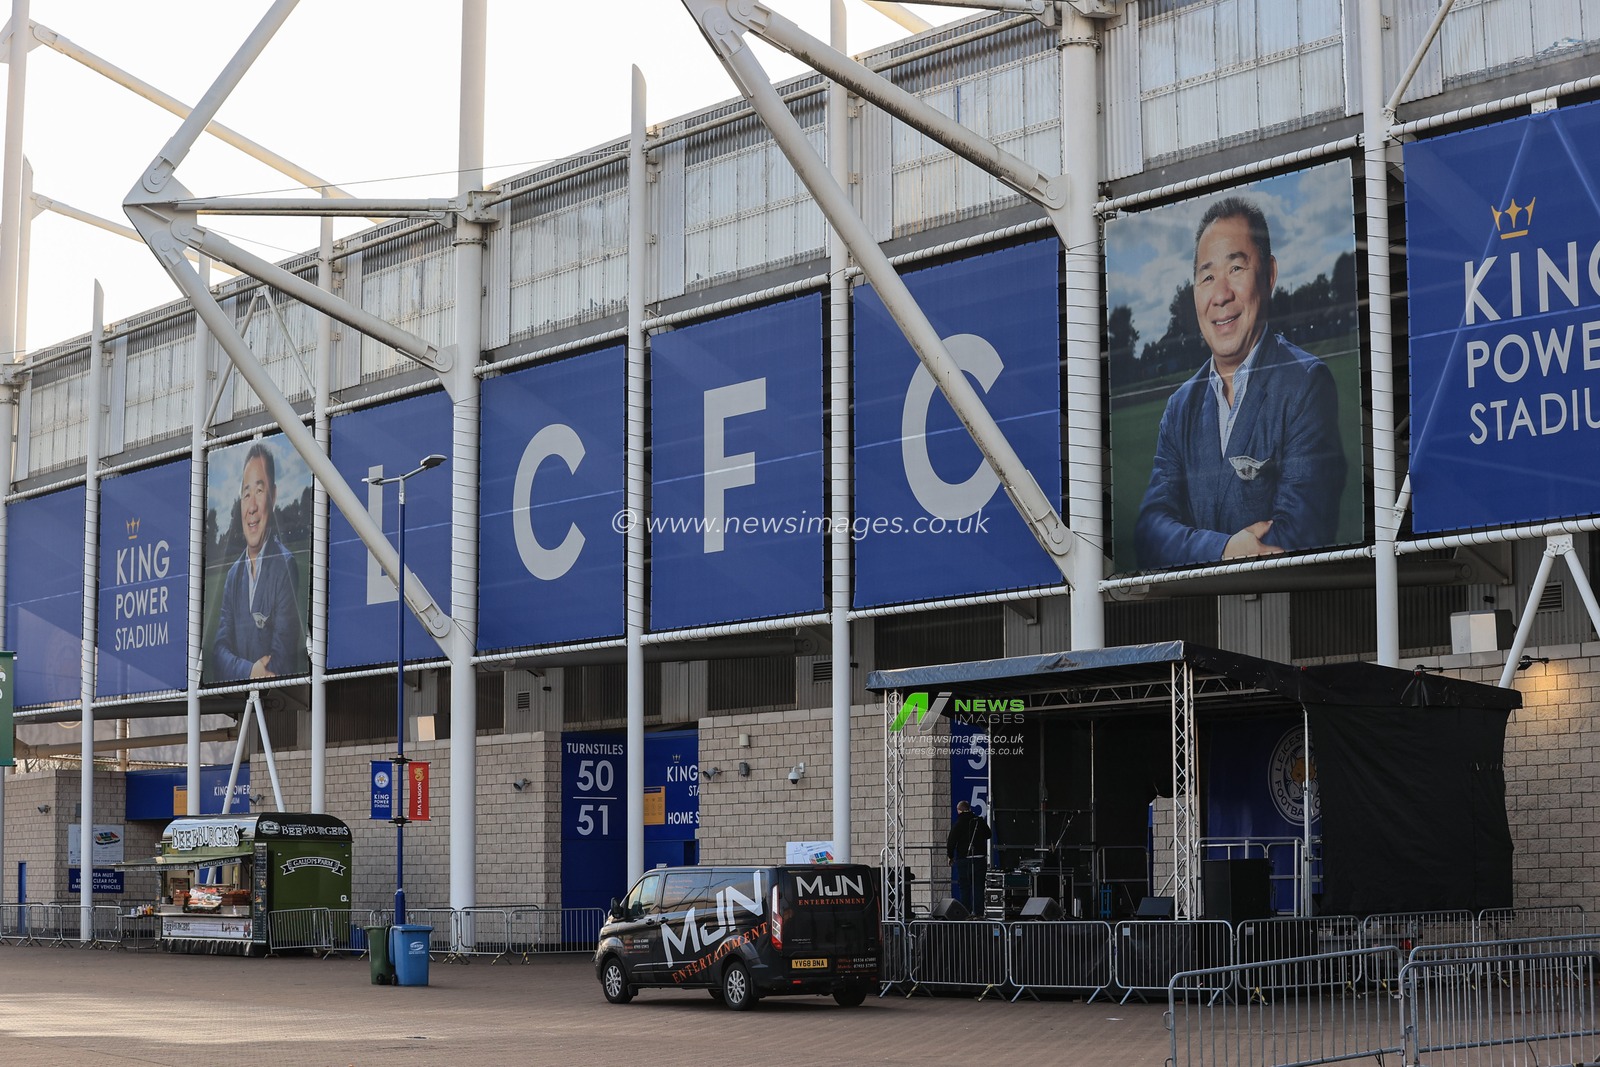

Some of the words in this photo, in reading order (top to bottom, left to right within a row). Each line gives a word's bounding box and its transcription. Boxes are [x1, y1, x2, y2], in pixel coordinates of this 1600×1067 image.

[1464, 240, 1600, 326] KIN
[366, 464, 400, 606] L
[512, 423, 586, 581] C
[703, 376, 767, 554] F
[901, 333, 1005, 521] C
[116, 539, 170, 586] KING
[115, 586, 169, 620] POWER
[115, 621, 169, 652] STADIUM
[566, 742, 624, 755] TURNSTILES
[232, 784, 250, 795] OWER
[576, 760, 614, 792] 50
[666, 765, 698, 782] KING
[576, 804, 609, 836] 51
[667, 811, 693, 825] HOME
[796, 875, 864, 897] MJN
[661, 869, 764, 968] MJN
[671, 922, 768, 985] ENTERTAINMENT
[812, 959, 825, 967] BNA
